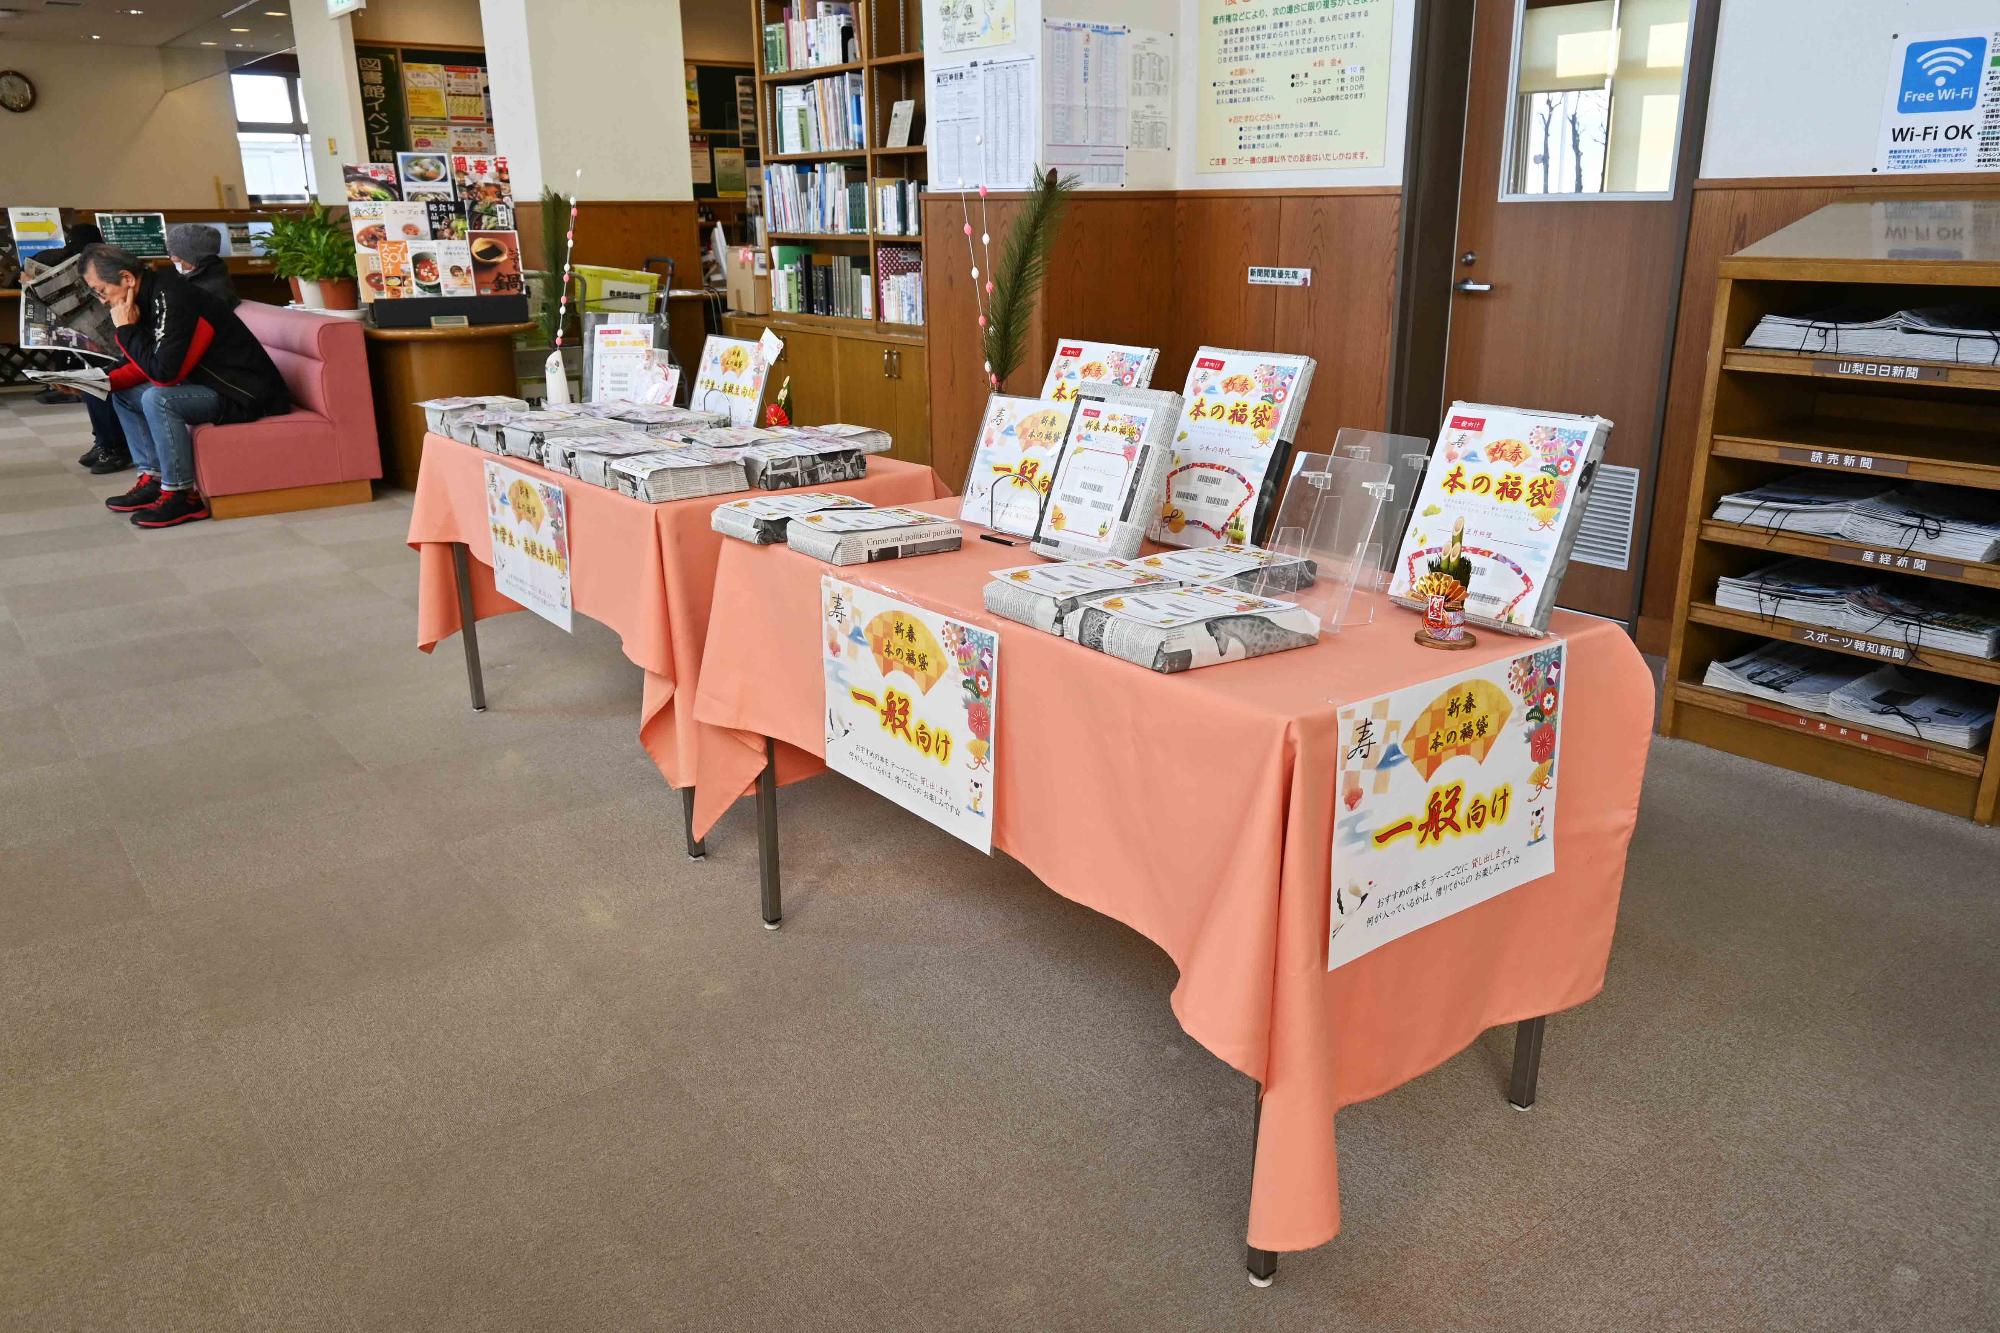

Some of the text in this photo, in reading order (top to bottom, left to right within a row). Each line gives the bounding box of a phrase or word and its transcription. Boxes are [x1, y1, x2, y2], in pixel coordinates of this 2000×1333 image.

[1904, 87, 1974, 103] Free Wi-Fi
[1891, 124, 1975, 143] Wi-Fi OK
[1838, 361, 1918, 379] 山梨日日新聞
[1223, 377, 1250, 392] 新春
[1189, 398, 1272, 429] 本の福袋
[1454, 420, 1481, 430] 一般向け
[1489, 441, 1525, 462] 新春
[1810, 451, 1873, 469] 読売新聞
[1442, 466, 1555, 508] 本の福袋
[1862, 550, 1927, 571] 産経新聞
[828, 593, 847, 625] 寿
[893, 620, 916, 643] 新春
[1803, 629, 1905, 660] スポーツ報知新聞
[884, 639, 929, 672] 本の福袋
[1446, 692, 1477, 718] 新春
[851, 689, 951, 762] 一般向け
[1346, 717, 1377, 759] 寿
[1429, 714, 1490, 753] 本の福袋
[1374, 785, 1510, 845] 一般向け
